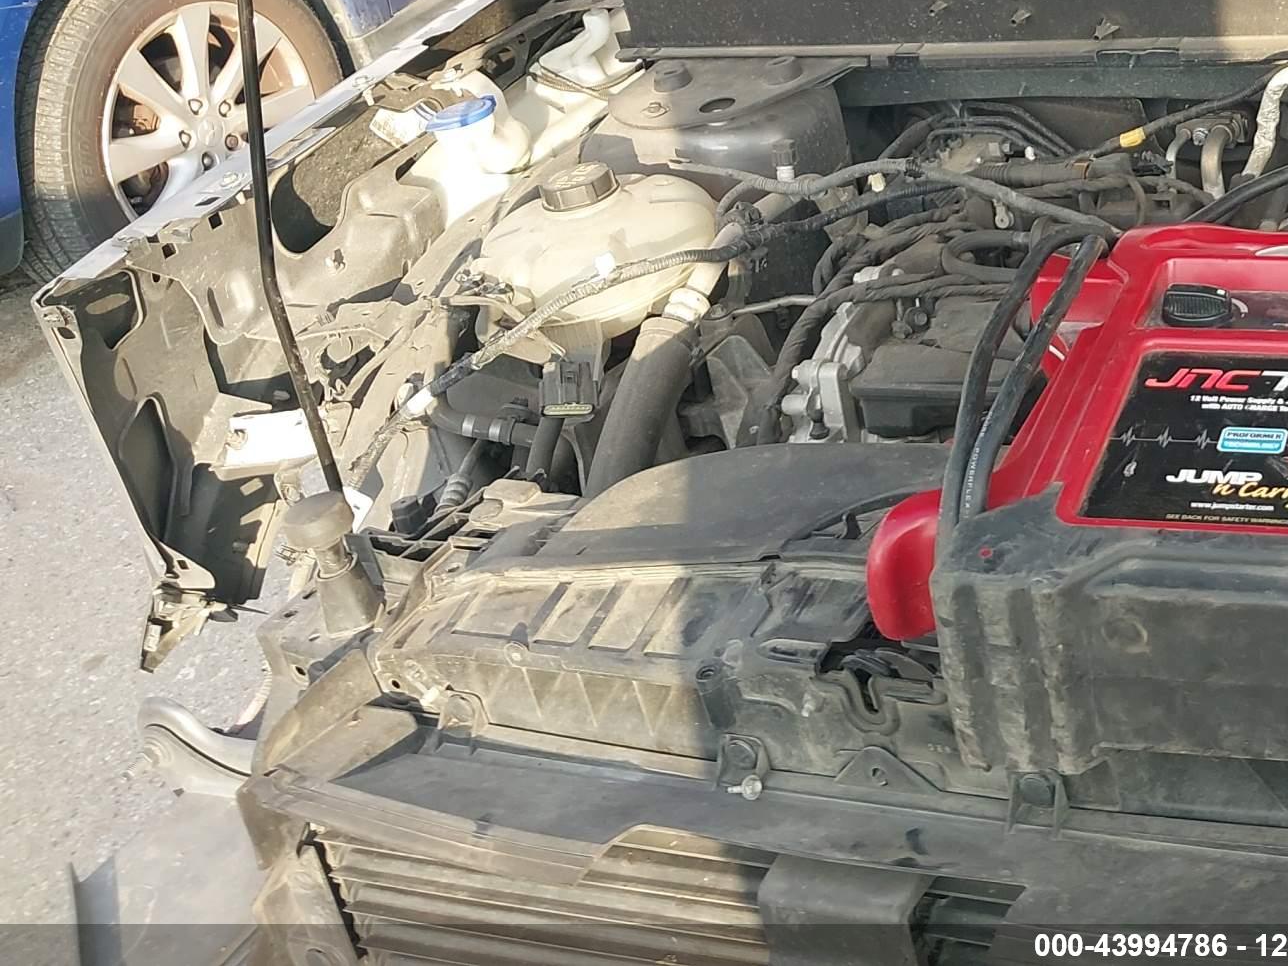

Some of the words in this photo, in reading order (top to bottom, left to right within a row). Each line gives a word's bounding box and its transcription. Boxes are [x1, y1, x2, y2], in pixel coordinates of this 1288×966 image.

[1247, 397, 1276, 405] Supply
[1165, 469, 1263, 484] JUMP
[1212, 483, 1235, 495] n
